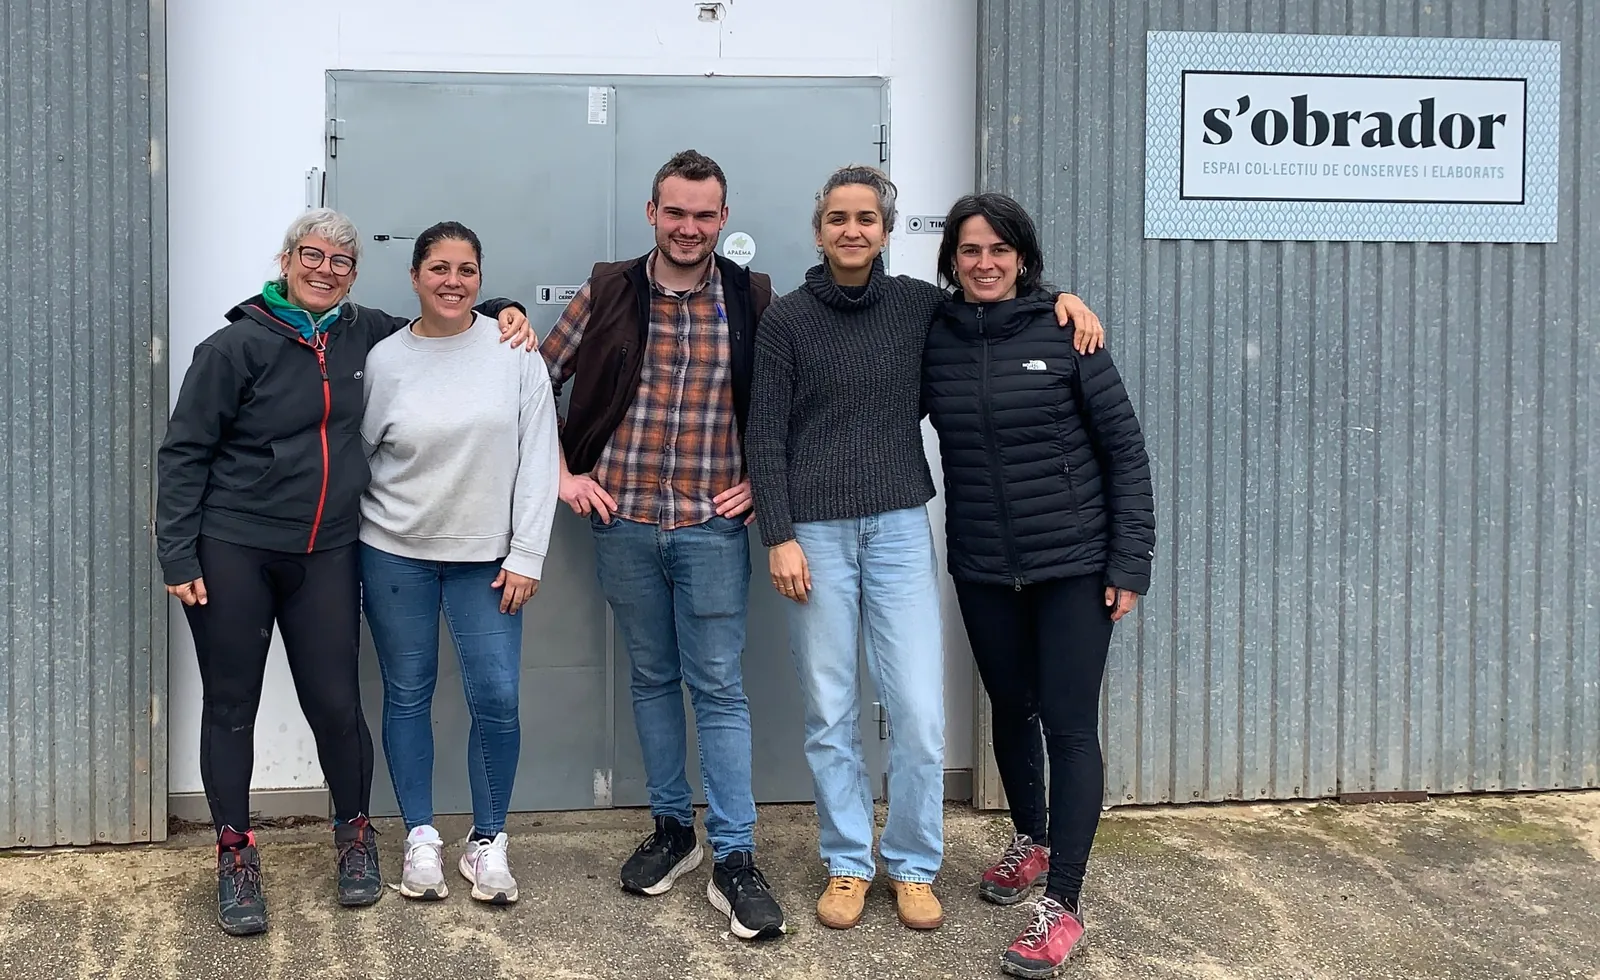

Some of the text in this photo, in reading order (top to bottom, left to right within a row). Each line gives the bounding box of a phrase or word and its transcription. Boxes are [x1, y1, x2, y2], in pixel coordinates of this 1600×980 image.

[1202, 94, 1507, 150] s’obrador
[1202, 161, 1240, 175] ESPAI
[1322, 163, 1339, 177] DE
[1343, 164, 1419, 178] CONSERVES
[1431, 166, 1505, 180] ELABORATS
